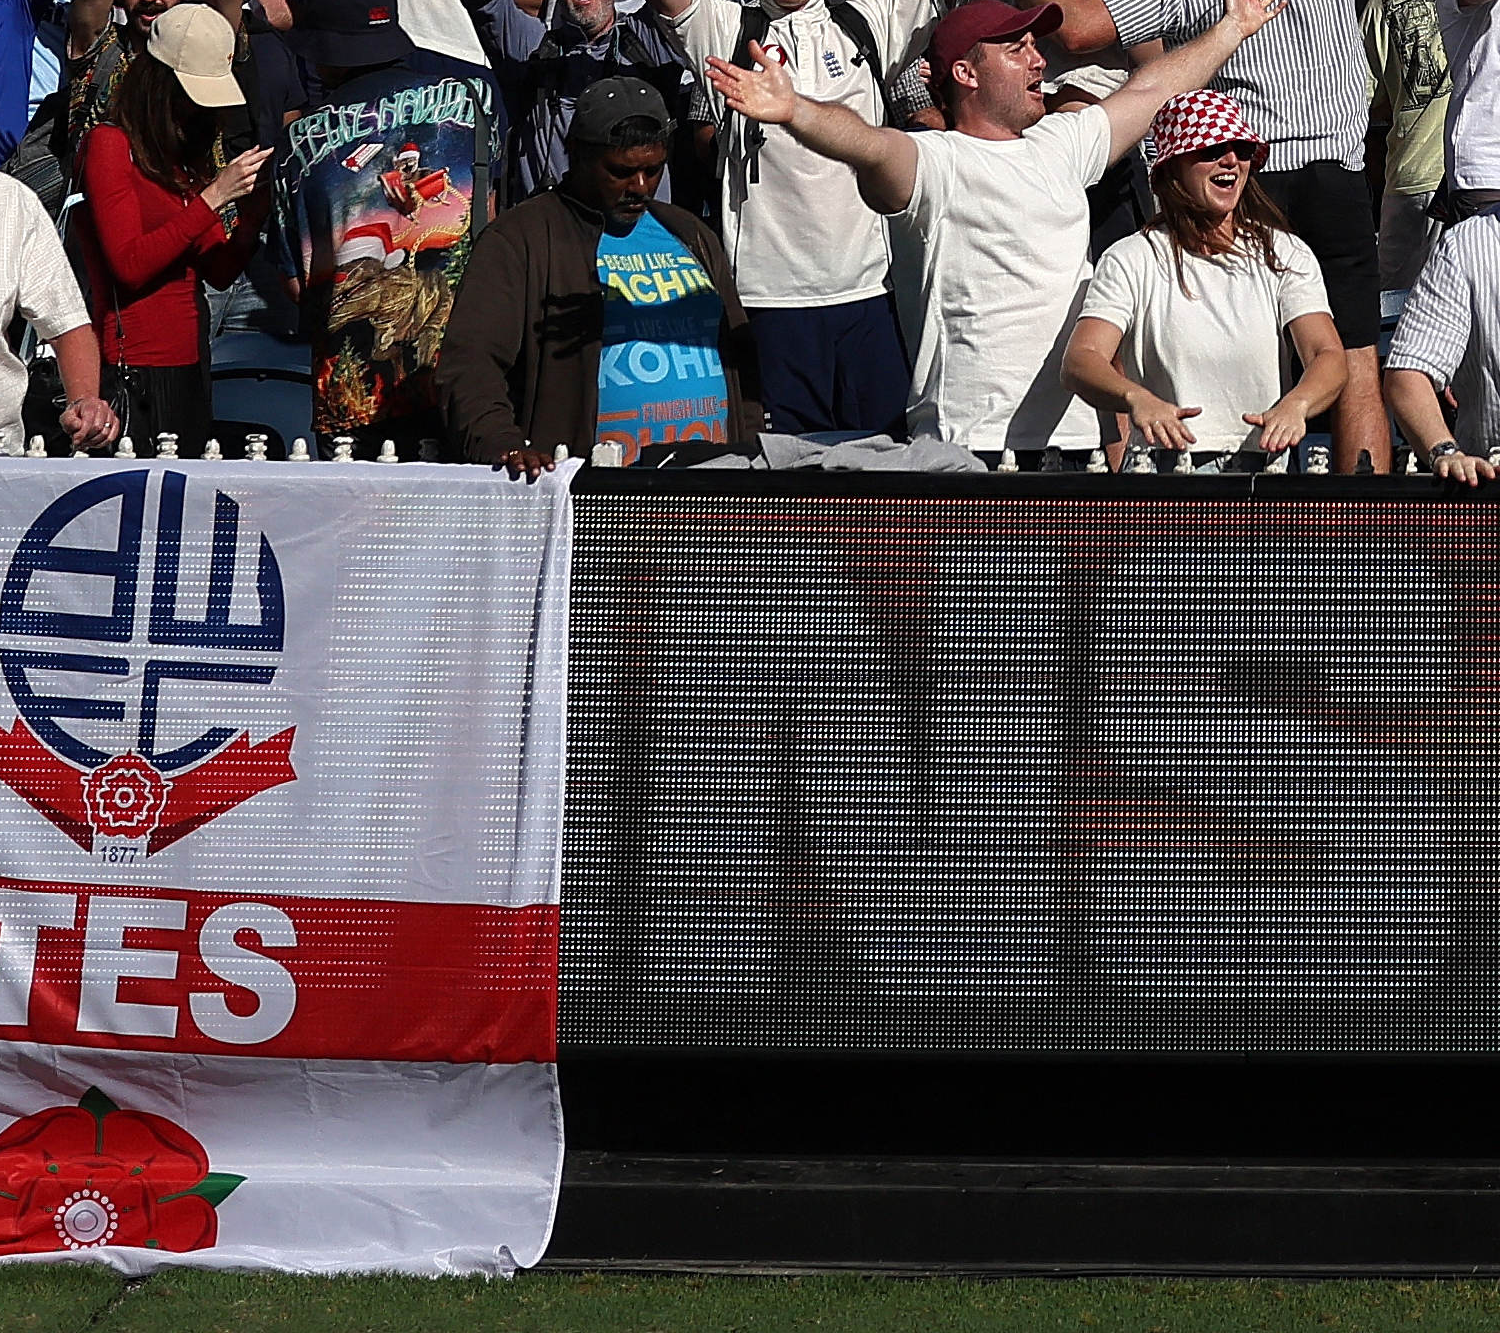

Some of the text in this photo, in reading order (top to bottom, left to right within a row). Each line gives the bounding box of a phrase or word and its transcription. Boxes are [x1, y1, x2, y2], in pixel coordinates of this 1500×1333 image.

[603, 252, 678, 272] BEGIN LIKE
[599, 340, 724, 389] KOHL
[641, 396, 719, 423] FINISH LIKE
[99, 844, 138, 865] 1877
